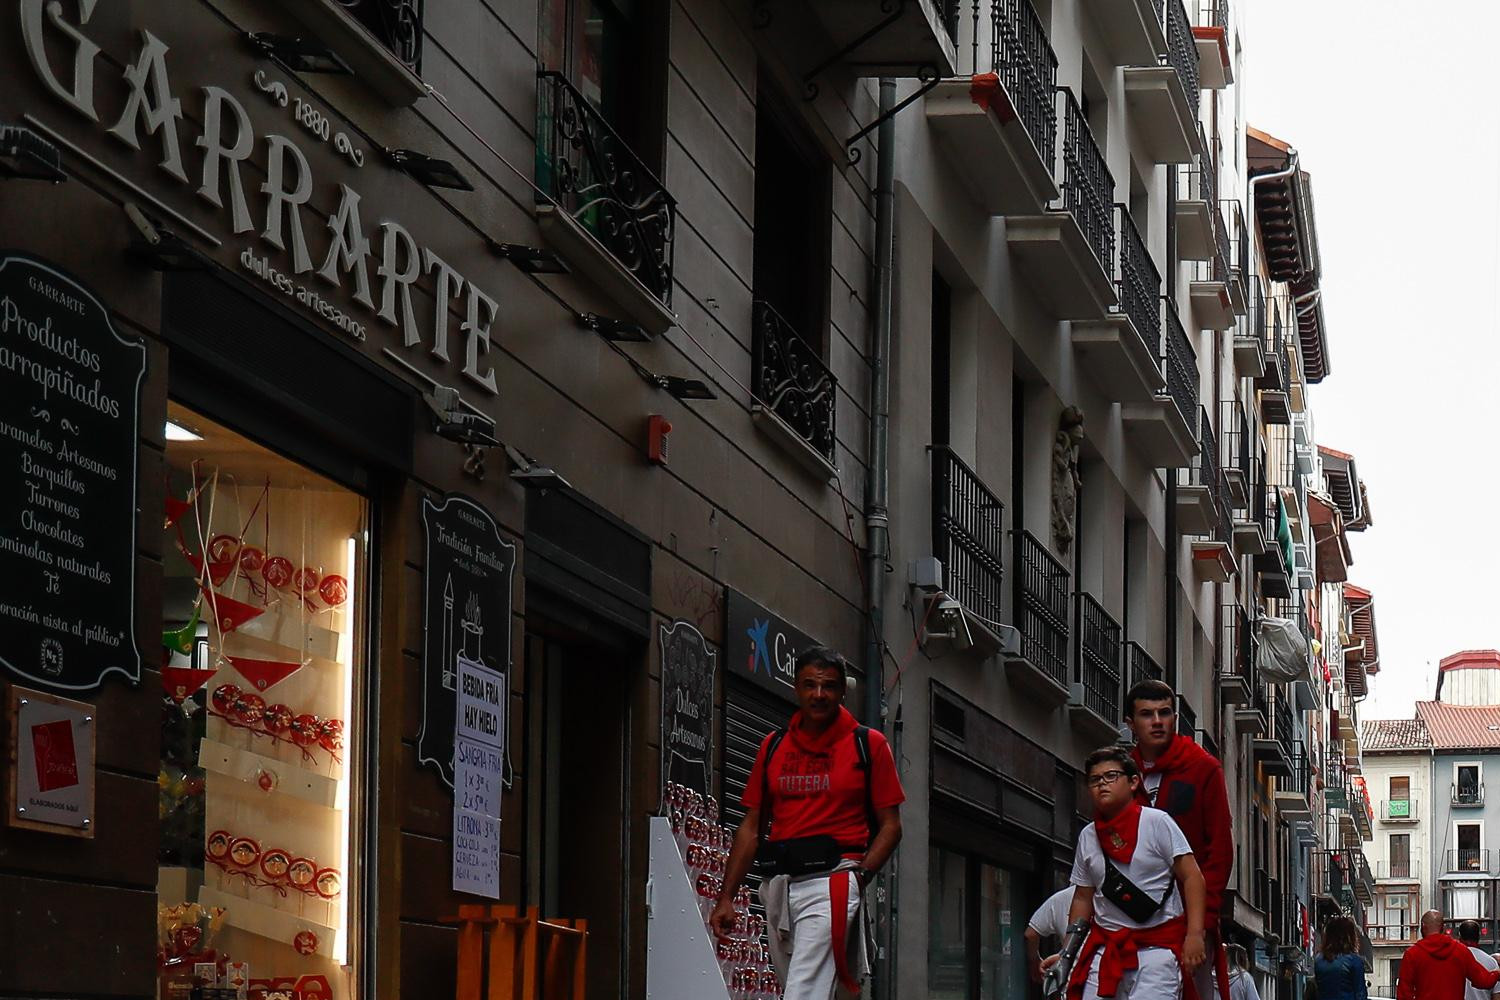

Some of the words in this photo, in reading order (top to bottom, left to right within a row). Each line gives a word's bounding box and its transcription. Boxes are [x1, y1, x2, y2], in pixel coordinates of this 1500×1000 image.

[294, 97, 330, 142] 1880
[20, 0, 500, 395] GARRARTE
[28, 276, 86, 316] GARRARTE
[240, 247, 293, 297] dulces
[296, 284, 366, 342] artesanos
[1, 296, 101, 373] Productos
[21, 450, 85, 494] Barquillos
[56, 440, 117, 480] Artesanos
[25, 480, 80, 520] Turrones
[21, 509, 84, 548] Chocolates
[43, 570, 61, 595] Té
[57, 555, 111, 584] naturales
[72, 619, 83, 637] al
[774, 632, 798, 679] Cai
[462, 671, 484, 701] BEBIDA
[464, 705, 478, 730] HAY
[479, 710, 498, 737] HIELO
[777, 774, 831, 792] TUTERA
